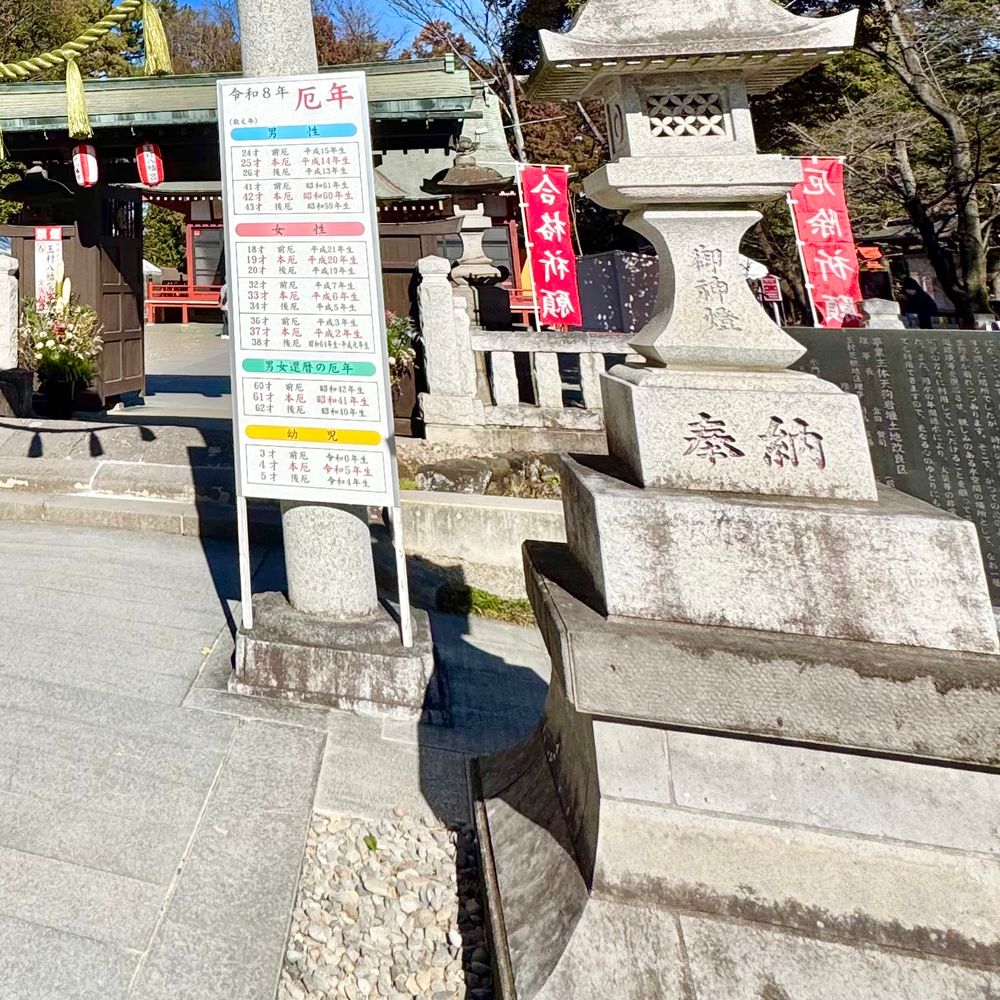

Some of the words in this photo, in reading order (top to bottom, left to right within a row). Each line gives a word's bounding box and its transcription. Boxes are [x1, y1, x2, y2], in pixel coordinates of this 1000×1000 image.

[230, 86, 289, 101] 令和8年
[295, 83, 354, 111] 厄年
[242, 149, 259, 157] 24才
[271, 148, 289, 156] 前厄
[304, 147, 346, 155] 平成15年生
[241, 159, 261, 167] 25才
[271, 157, 291, 167] 本厄
[301, 156, 350, 166] 平成14年生
[243, 169, 260, 177] 26才
[273, 168, 290, 176] 後厄
[305, 167, 348, 175] 平成13年生
[244, 183, 261, 191] 41才
[273, 182, 291, 190] 前厄
[243, 192, 263, 201] 42才
[273, 192, 293, 201] 本厄
[245, 203, 262, 211] 43才
[275, 202, 292, 210] 後厄
[277, 245, 295, 253] 前厄
[310, 245, 354, 254] 平成21年生
[247, 255, 266, 265] 19才
[277, 255, 297, 264] 本厄
[308, 255, 358, 265] 平成20年生
[248, 266, 266, 274] 20才
[279, 266, 296, 274] 後厄
[312, 267, 355, 275] 平成19年生
[249, 281, 267, 289] 32才
[279, 281, 298, 289] 前厄
[315, 281, 355, 290] 平成7年生
[248, 291, 269, 300] 33才
[279, 291, 300, 300] 本厄
[312, 292, 359, 301] 平成6年生
[250, 302, 268, 310] 34才
[281, 302, 299, 310] 後厄
[316, 303, 357, 312] 平成5年生
[251, 317, 269, 325] 36才
[281, 317, 300, 326] 前厄
[317, 318, 358, 327] 平成3年生
[250, 327, 270, 337] 37才
[281, 327, 302, 337] 本厄
[314, 328, 362, 338] 平成2年生
[252, 338, 270, 346] 38才
[283, 339, 301, 347] 後厄
[265, 361, 353, 375] 男女還暦の厄年
[254, 382, 272, 391] 60才
[285, 383, 304, 392] 前厄
[253, 392, 274, 402] 61才
[285, 394, 306, 403] 本厄
[317, 396, 369, 406] 昭和41年生
[255, 404, 274, 413] 62才
[287, 405, 305, 414] 後厄
[682, 412, 824, 470] 奉納
[289, 451, 308, 460] 前厄
[326, 453, 368, 465] 令和6年生
[289, 462, 310, 472] 本厄
[323, 462, 373, 476] 令和5年生
[291, 474, 310, 483] 後厄
[326, 475, 371, 489] 令和4年生
